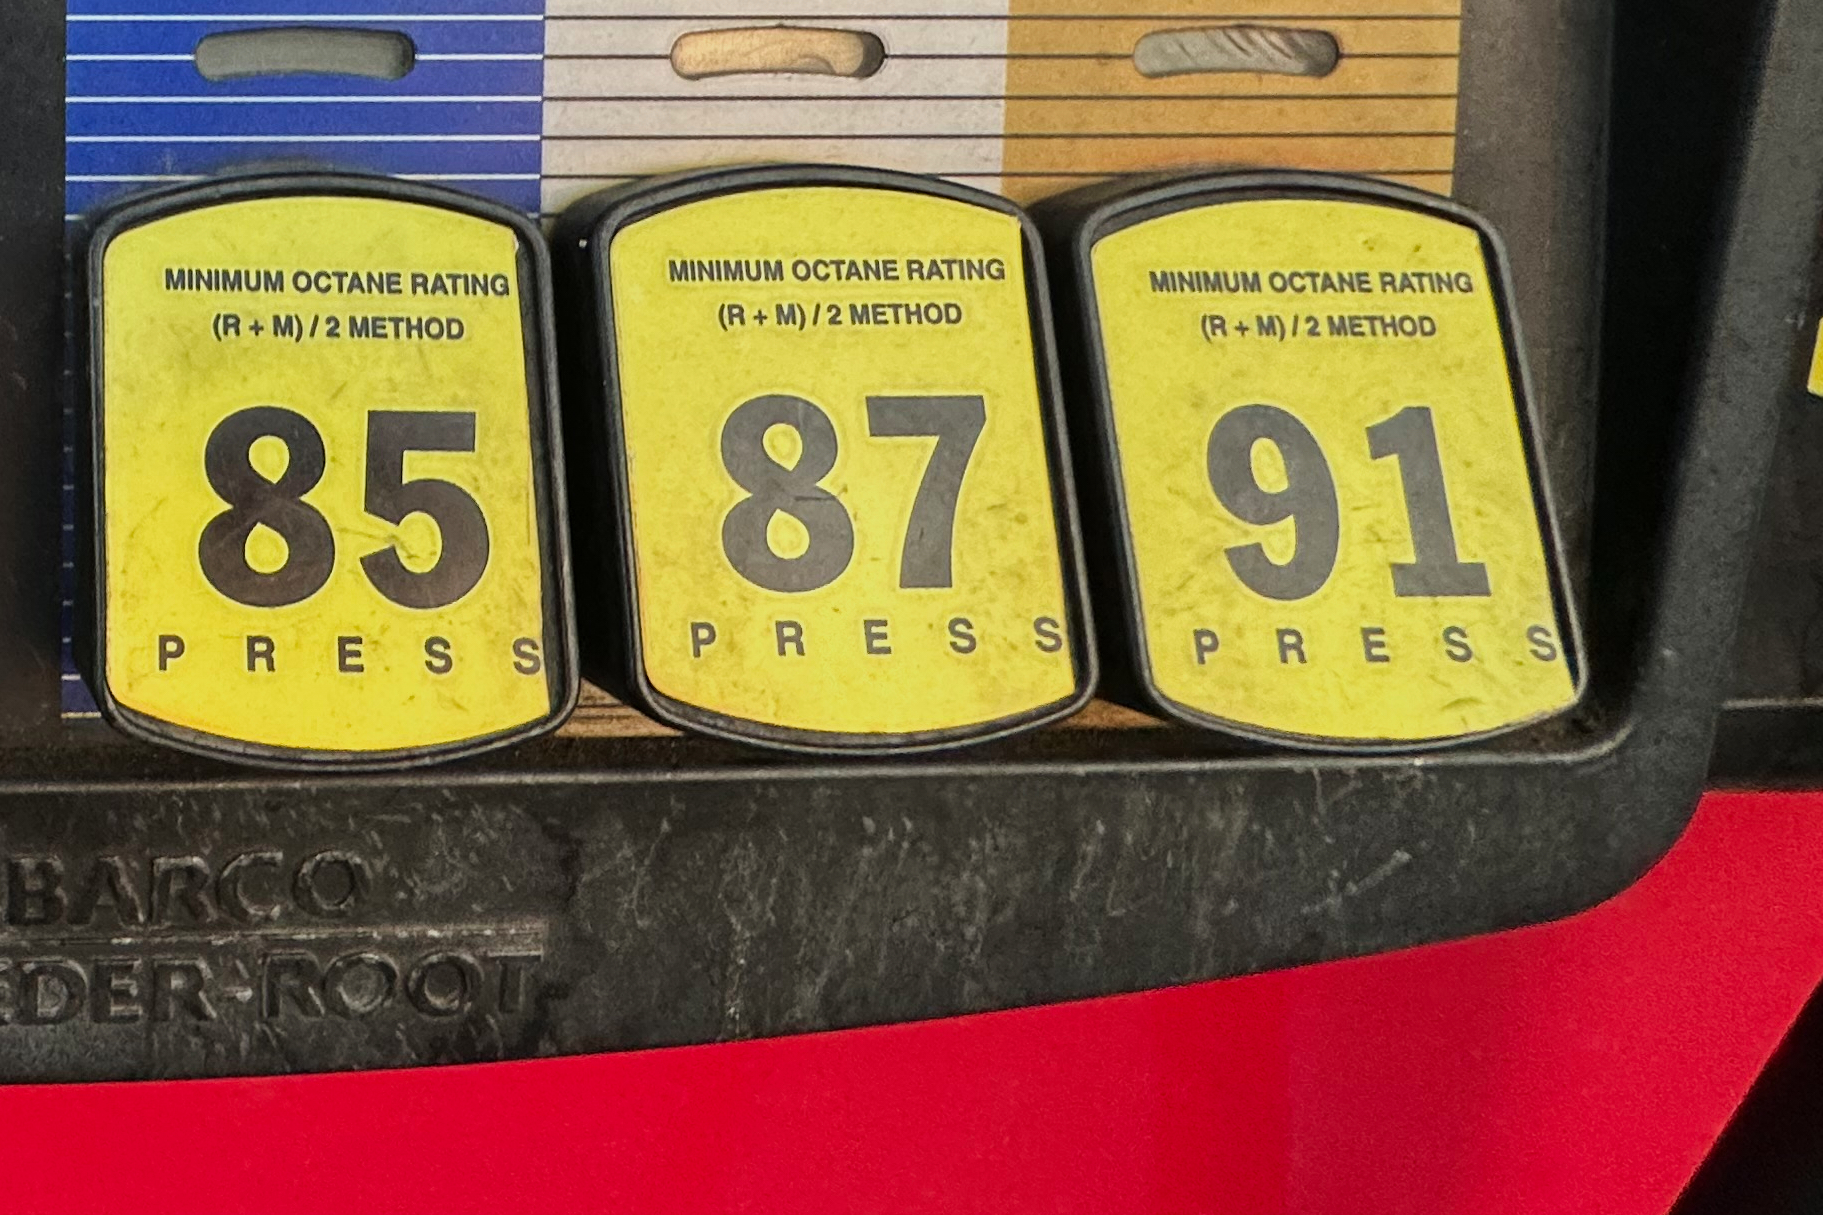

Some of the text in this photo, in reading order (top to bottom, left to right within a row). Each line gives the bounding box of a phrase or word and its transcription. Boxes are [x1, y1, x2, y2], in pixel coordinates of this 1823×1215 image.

[669, 259, 1005, 282] MINIMUM OCTANE RATING
[1149, 271, 1473, 293] MINIMUM OCTANE RATING
[165, 269, 509, 297] MINIMUM OCTANE RATING
[850, 304, 962, 325] METHOD
[1329, 315, 1436, 337] METHOD
[350, 317, 464, 340] METHOD
[720, 393, 986, 594] 87
[1207, 403, 1492, 601] 91
[198, 405, 489, 609] 85
